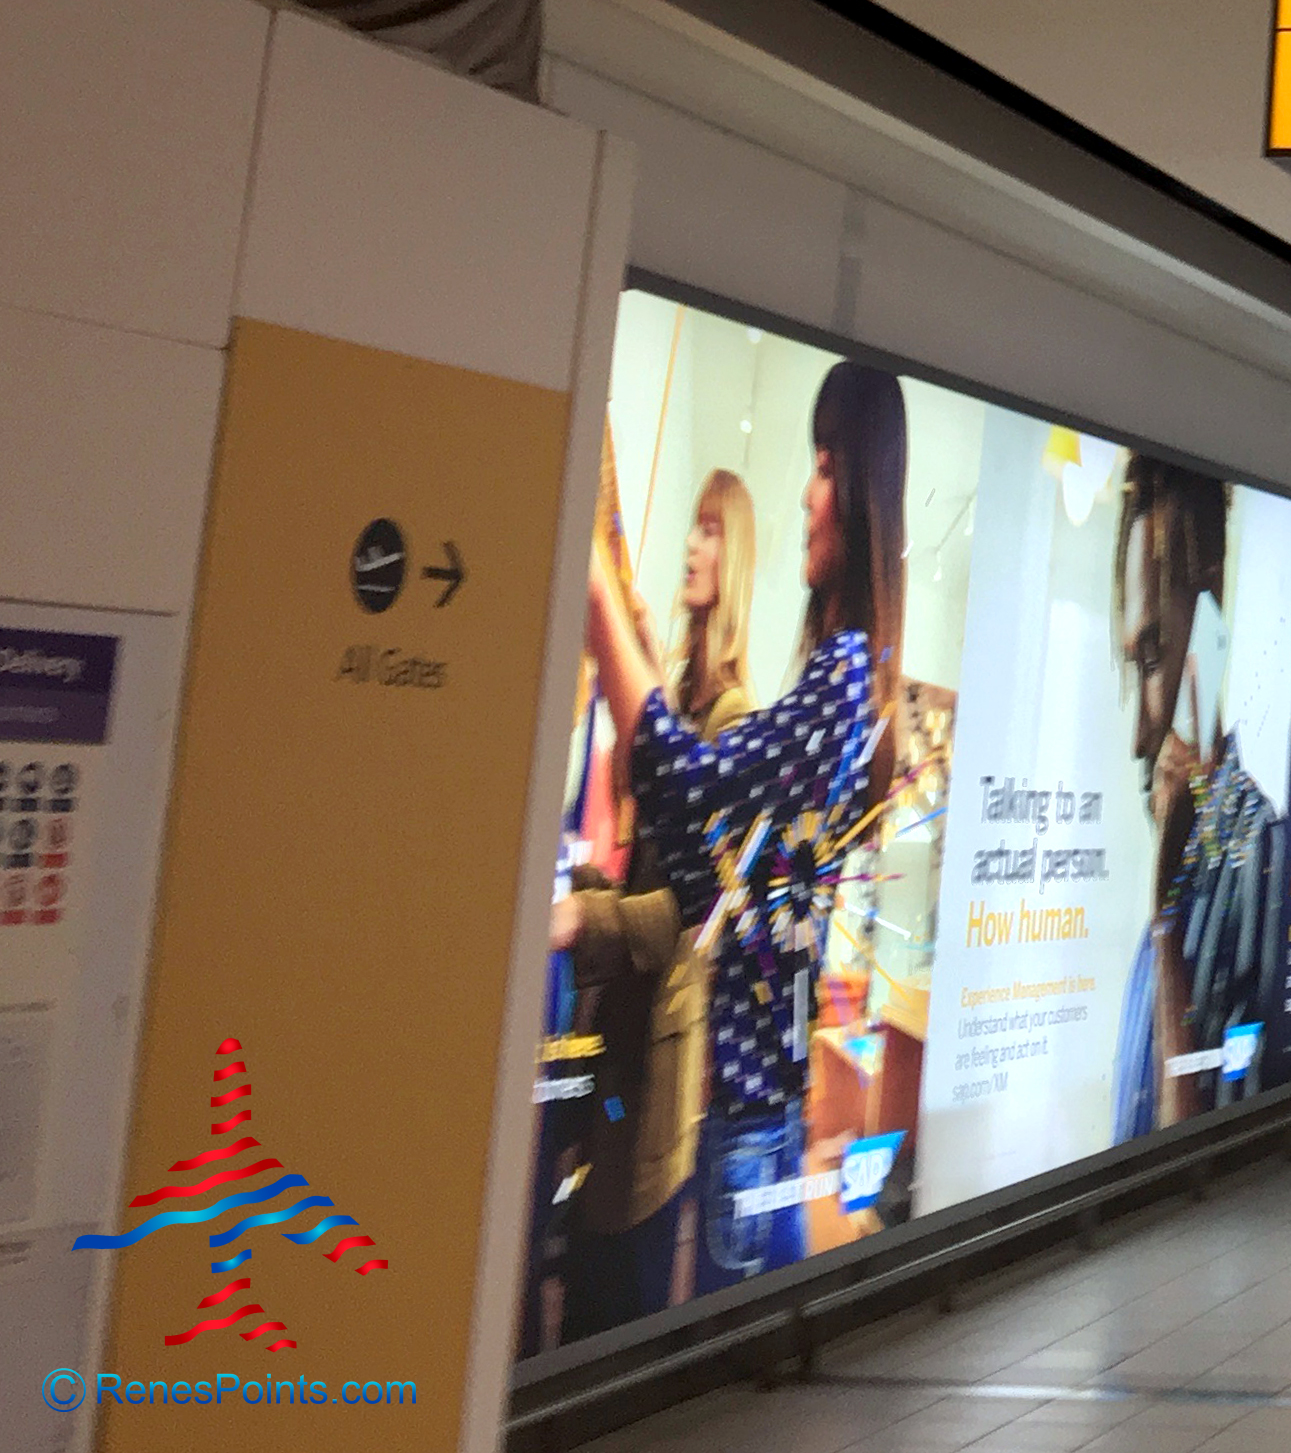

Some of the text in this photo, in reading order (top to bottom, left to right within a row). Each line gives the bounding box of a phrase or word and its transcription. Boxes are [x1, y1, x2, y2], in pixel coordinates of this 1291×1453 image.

[379, 647, 447, 689] Gates
[979, 774, 1053, 835] Talking
[971, 837, 1038, 886] actual
[966, 898, 1089, 948] How human.
